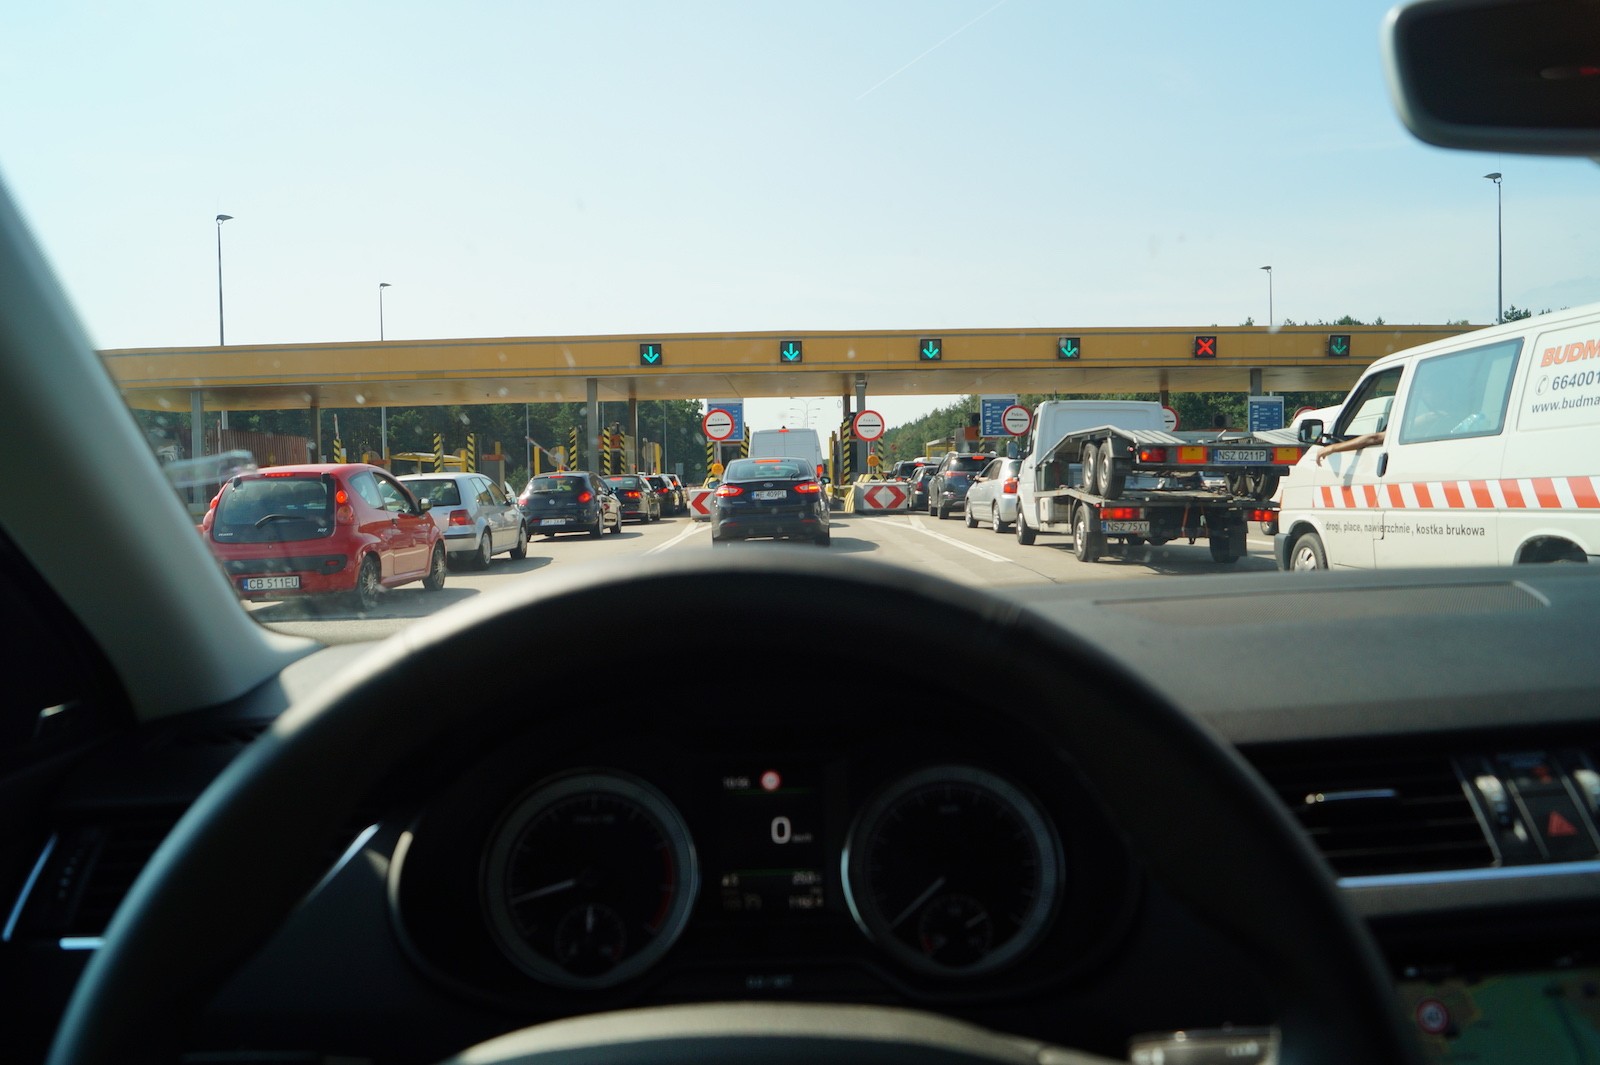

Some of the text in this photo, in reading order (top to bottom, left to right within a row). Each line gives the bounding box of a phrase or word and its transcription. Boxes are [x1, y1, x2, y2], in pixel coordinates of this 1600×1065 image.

[1219, 451, 1265, 460] NSZ 0211P
[1108, 522, 1148, 531] NSZ 75XY
[1416, 523, 1443, 535] kostka
[1446, 524, 1485, 536] brukowa
[249, 577, 298, 589] CB 511EU
[771, 816, 791, 844] 0
